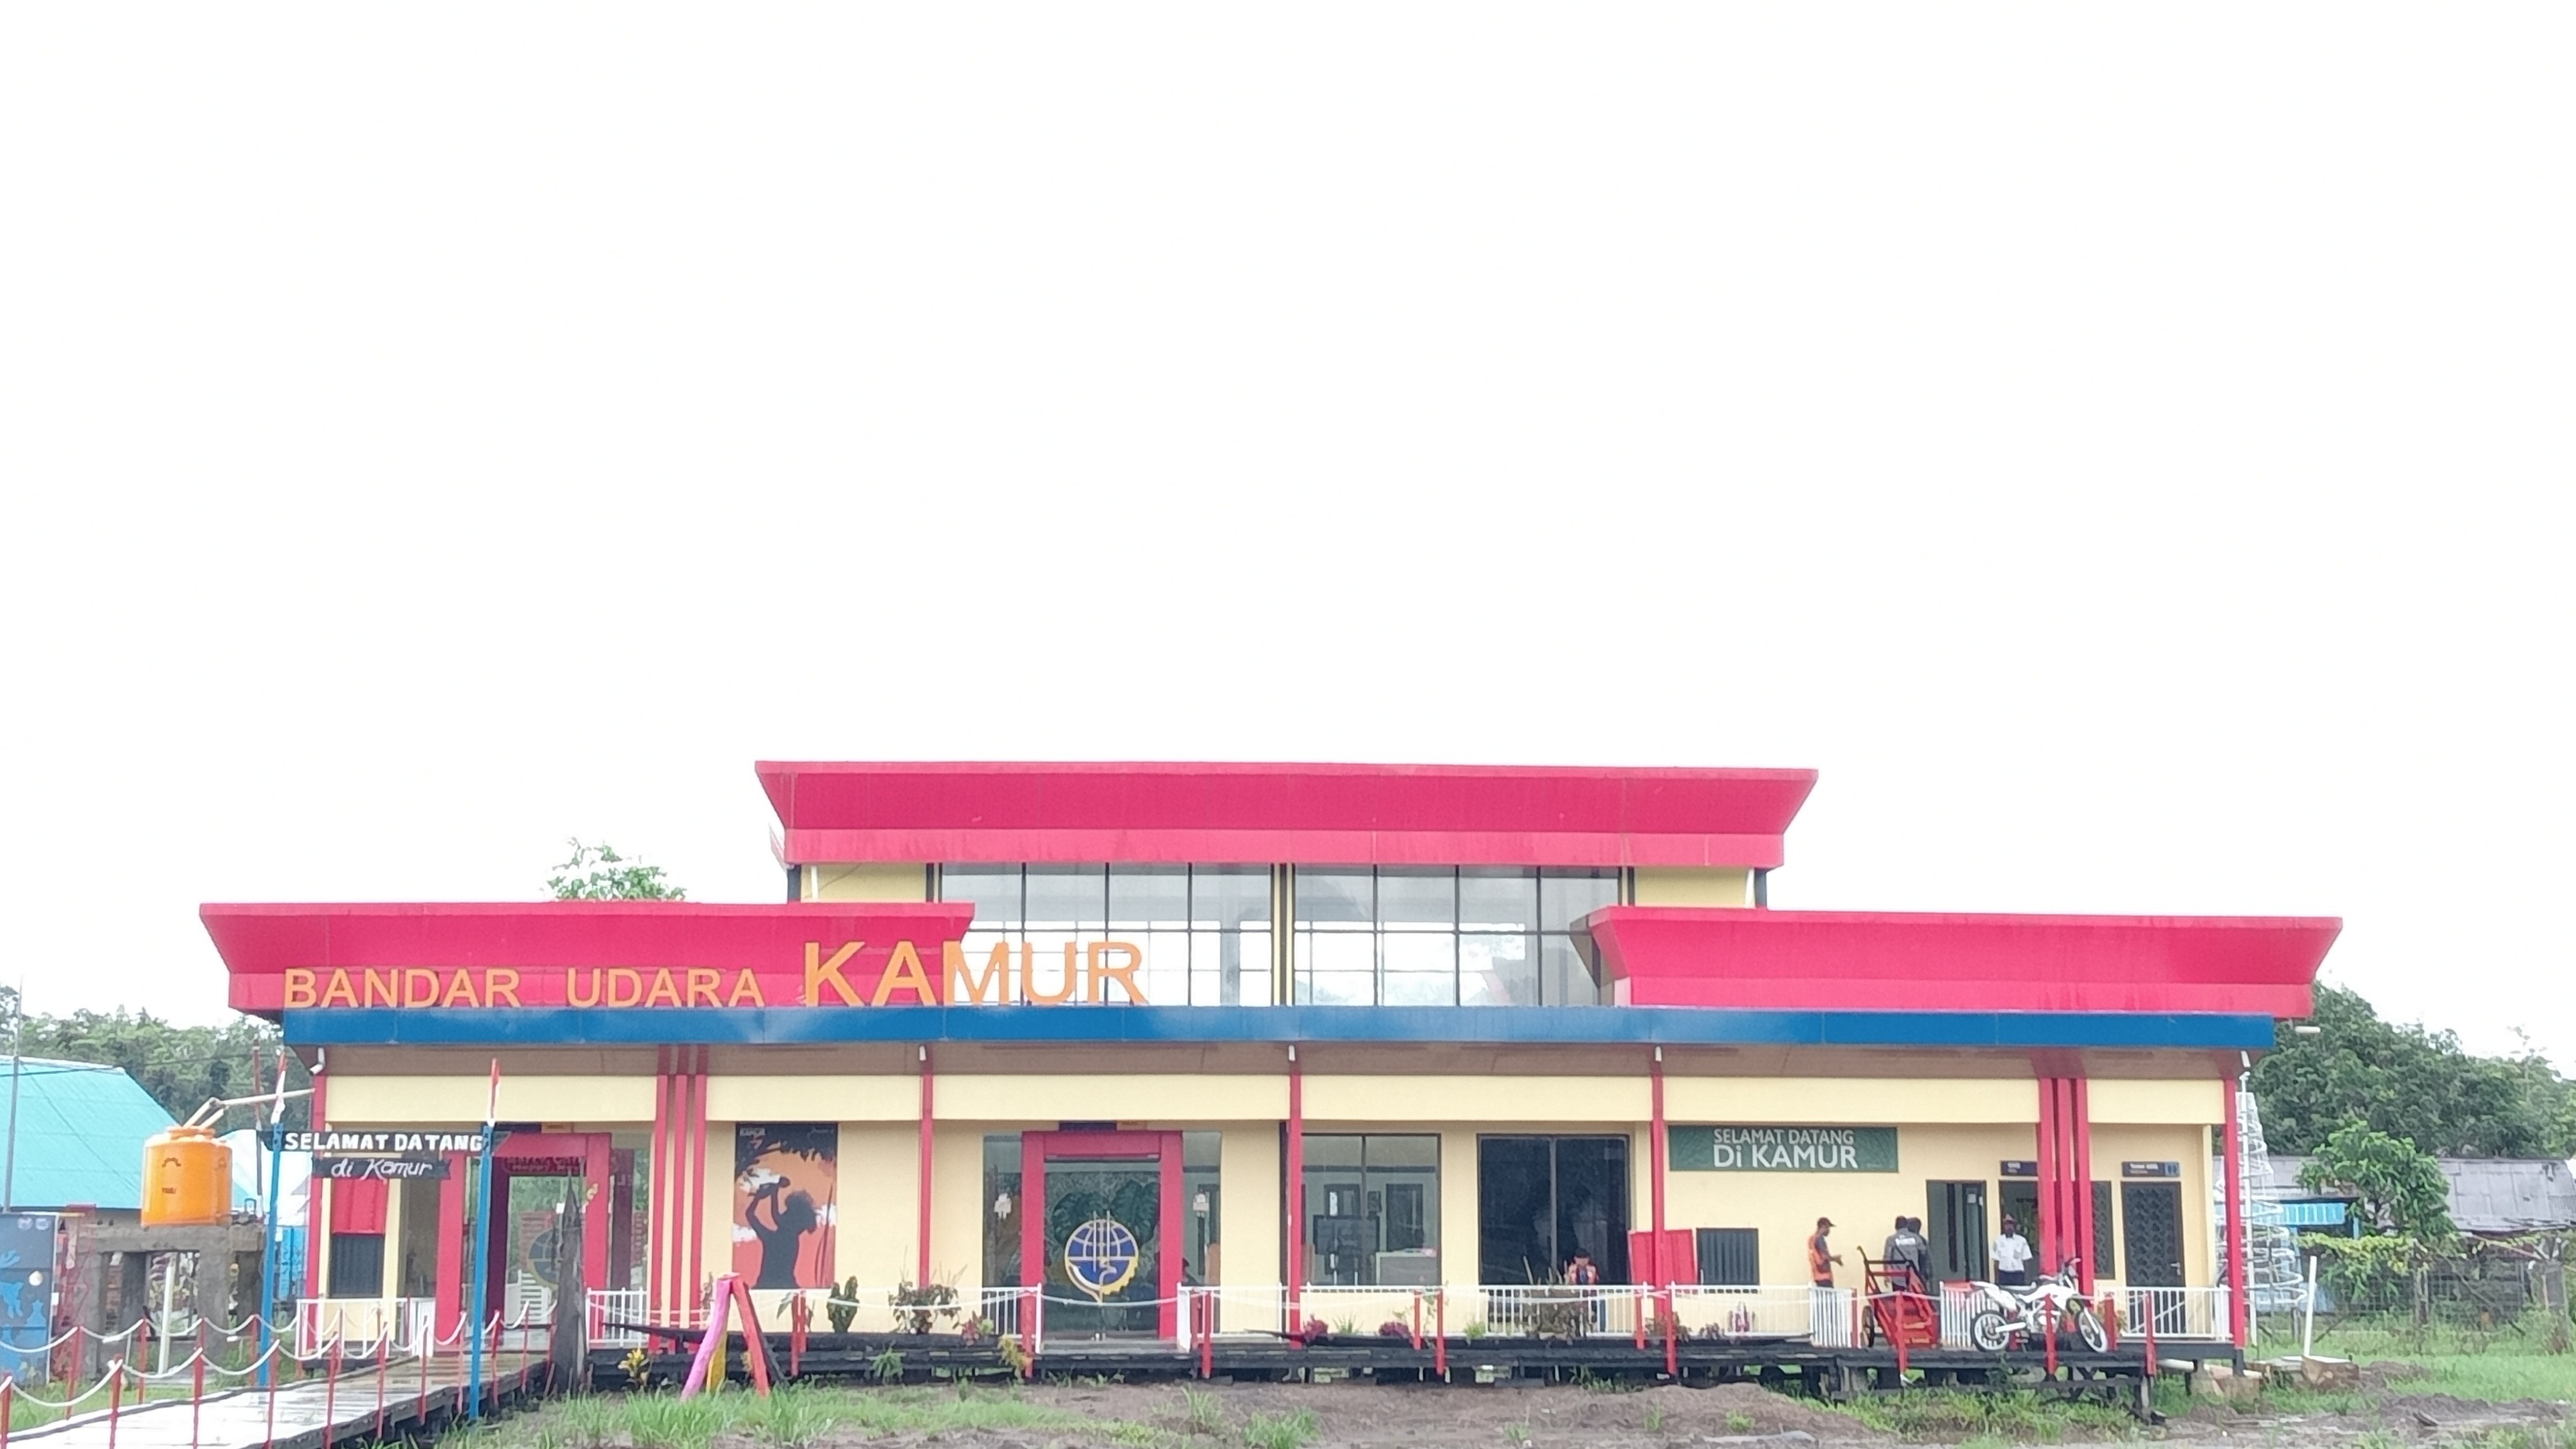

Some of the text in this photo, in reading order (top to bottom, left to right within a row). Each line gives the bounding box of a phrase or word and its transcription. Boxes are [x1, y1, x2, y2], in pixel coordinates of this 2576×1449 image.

[285, 940, 1150, 1009] BANDAR UDARA KAMUR
[285, 1132, 482, 1151] SELAMAT DATANG
[1714, 1129, 1854, 1145] SELAMAT DATANG
[1714, 1144, 1858, 1169] Di KAMUR
[330, 1159, 353, 1177] di
